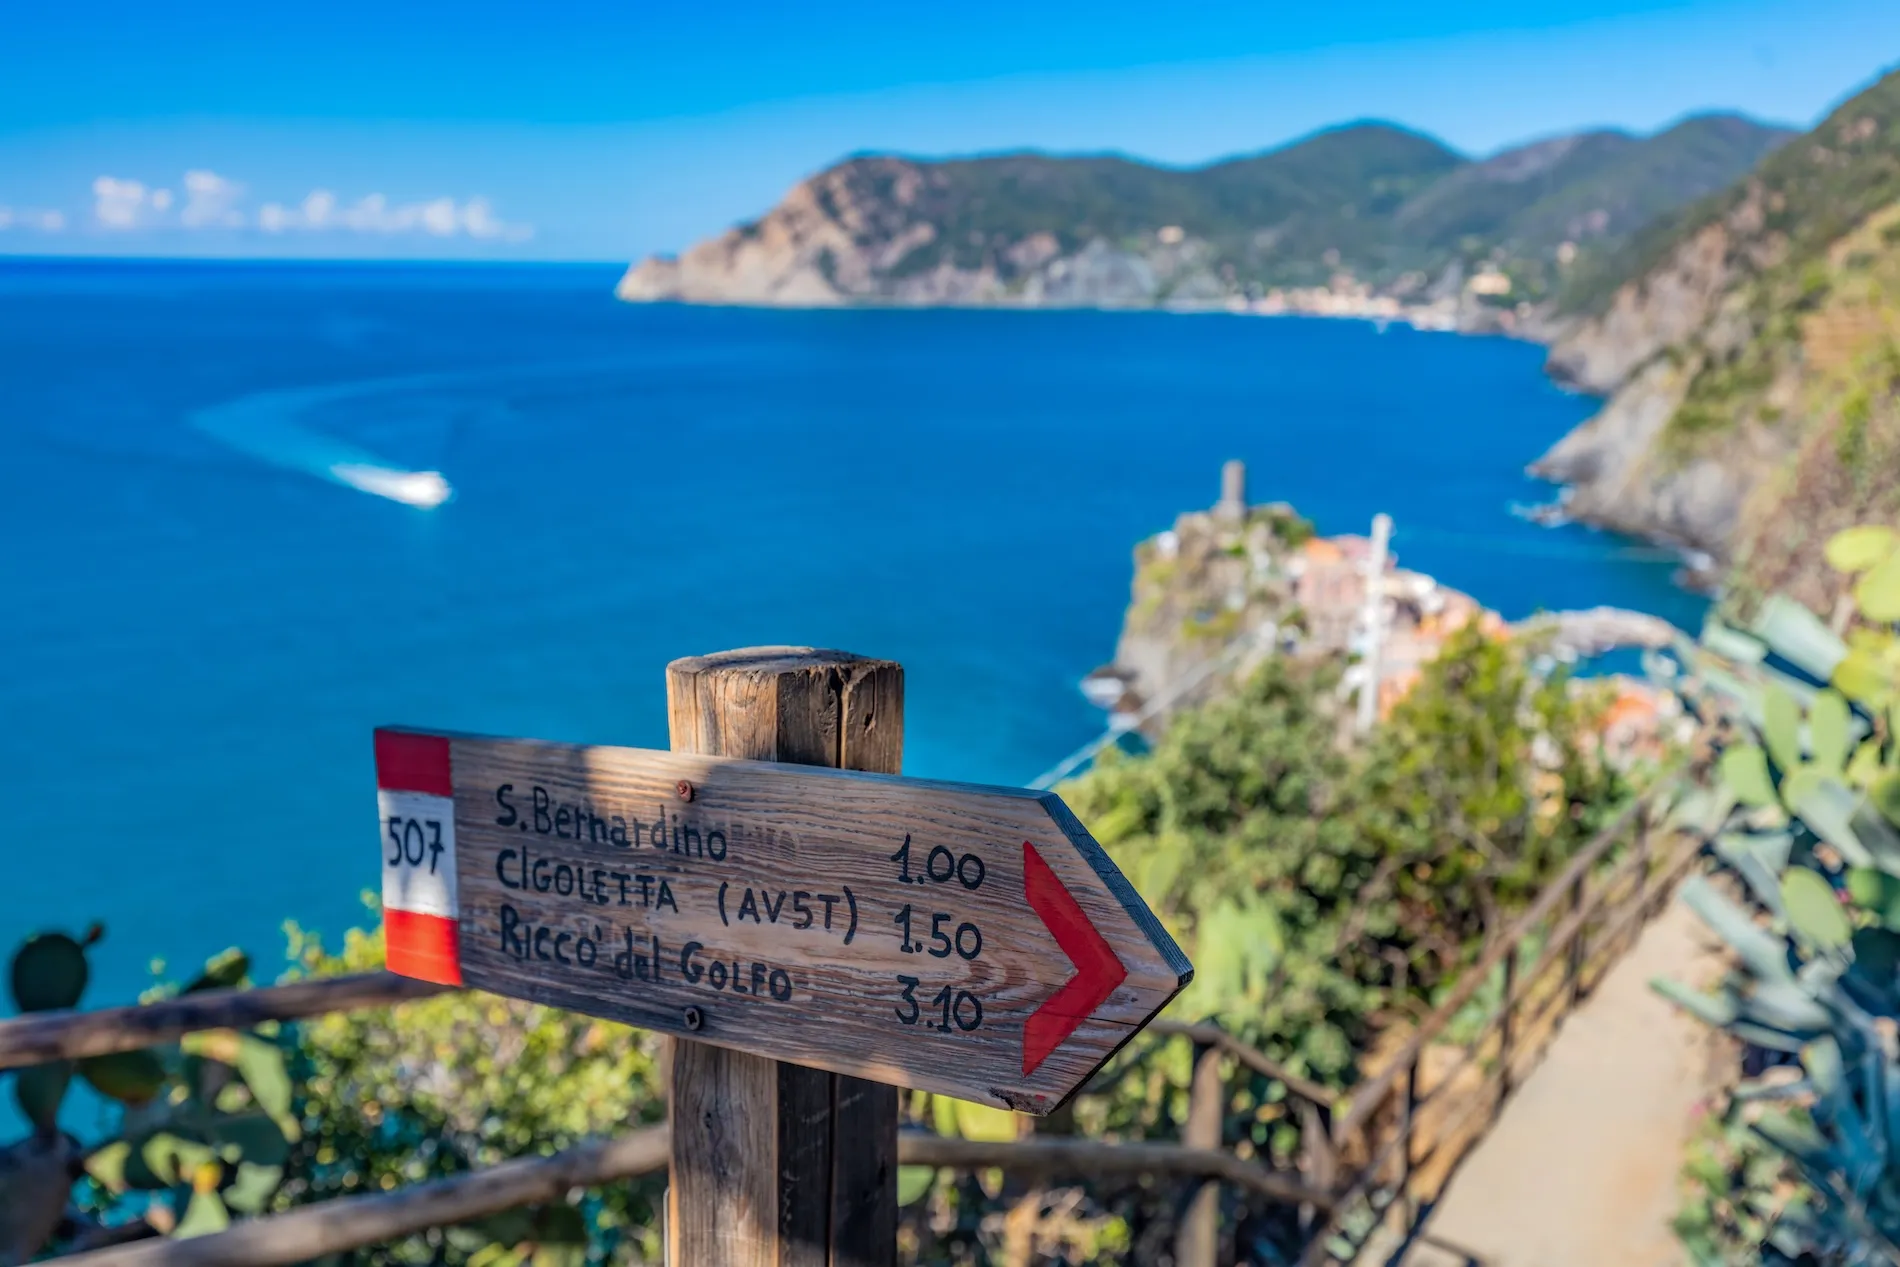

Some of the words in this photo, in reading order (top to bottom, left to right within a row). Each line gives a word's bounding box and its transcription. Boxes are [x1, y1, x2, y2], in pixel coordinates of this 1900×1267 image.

[387, 816, 445, 875] 507
[891, 834, 985, 890] 1.00
[495, 846, 679, 914] CIGOLETTA
[895, 903, 983, 960] 1.50
[614, 926, 661, 983] del
[681, 941, 793, 1001] GOLFO
[894, 974, 983, 1033] 3.10
